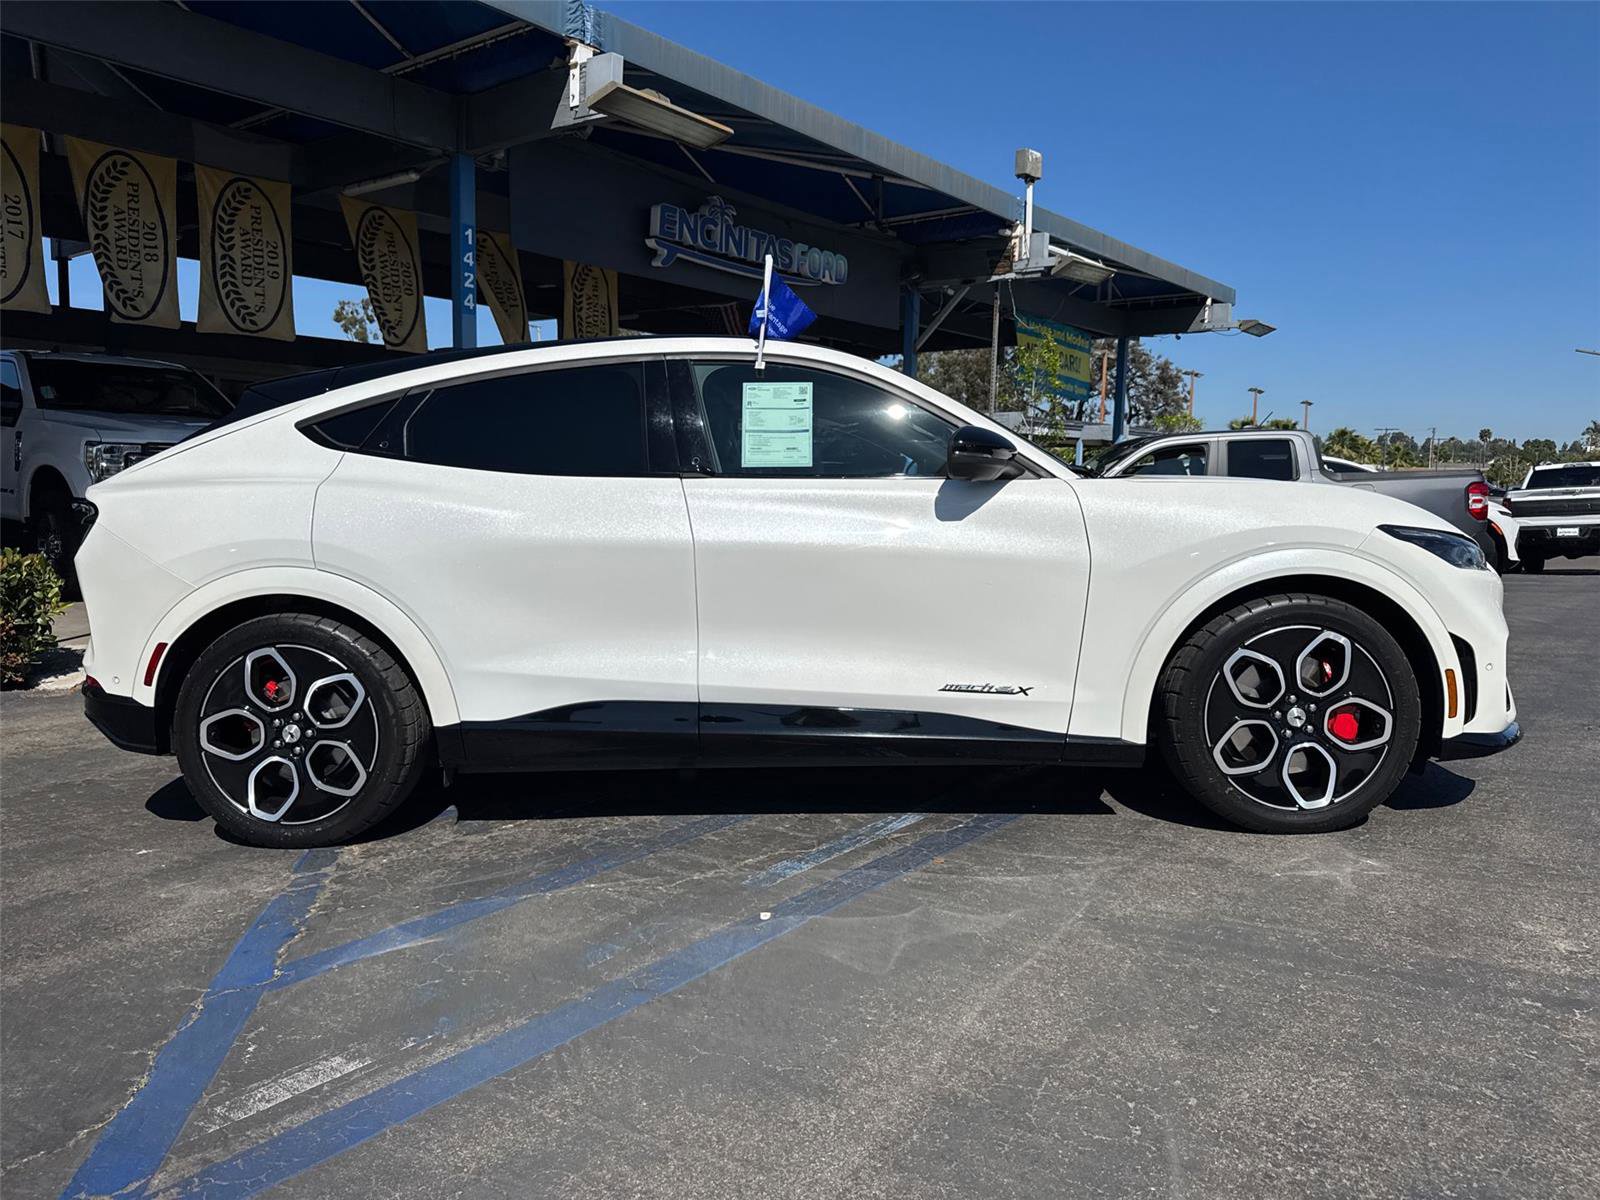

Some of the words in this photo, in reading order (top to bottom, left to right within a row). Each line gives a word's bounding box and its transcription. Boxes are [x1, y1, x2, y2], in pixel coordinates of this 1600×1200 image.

[4, 194, 24, 241] 2017
[113, 205, 129, 270] AWARD
[126, 181, 145, 299] PRESIDENT'S
[142, 222, 160, 263] 2018
[651, 199, 795, 271] ENCINITAS
[793, 243, 848, 285] FORD
[240, 227, 254, 288] AWARD
[250, 204, 266, 314] PRESIDENT'S
[266, 240, 280, 281] 2019
[377, 248, 392, 304] AWARD
[384, 231, 403, 328] PRESIDENT'S
[400, 262, 414, 297] 2020
